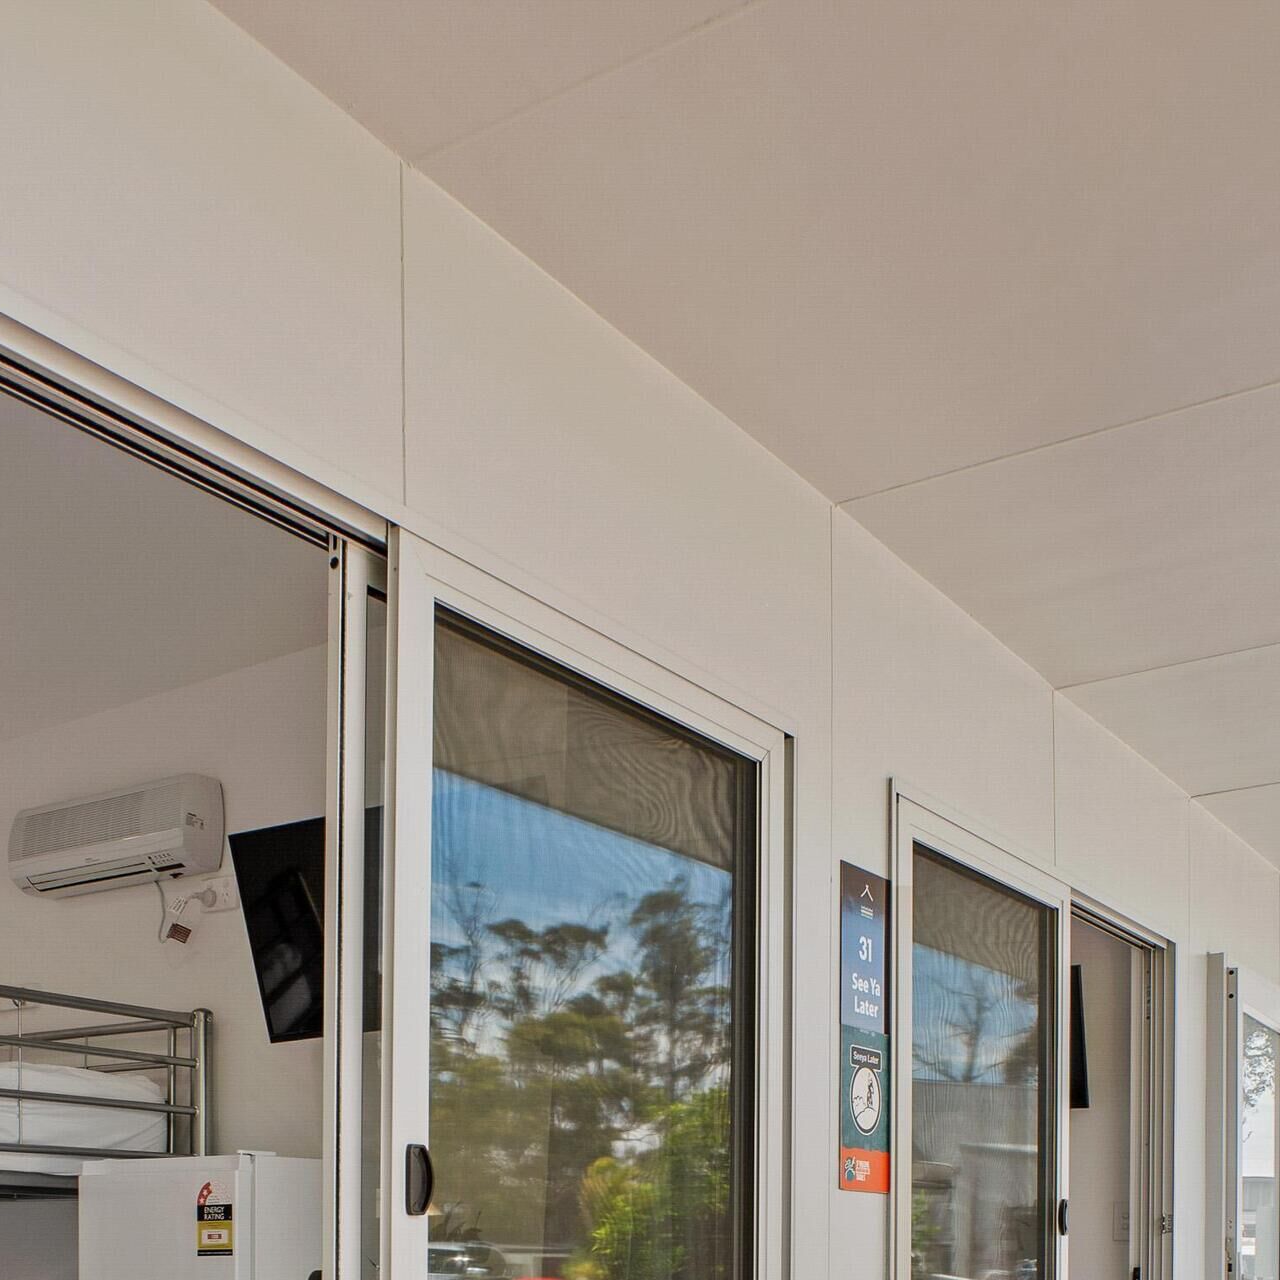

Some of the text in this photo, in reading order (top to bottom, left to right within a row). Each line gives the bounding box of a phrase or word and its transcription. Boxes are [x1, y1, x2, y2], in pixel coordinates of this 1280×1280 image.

[858, 935, 873, 963] 31
[852, 972, 881, 997] See Ya
[854, 995, 879, 1018] Later
[204, 1206, 225, 1214] ENERGY
